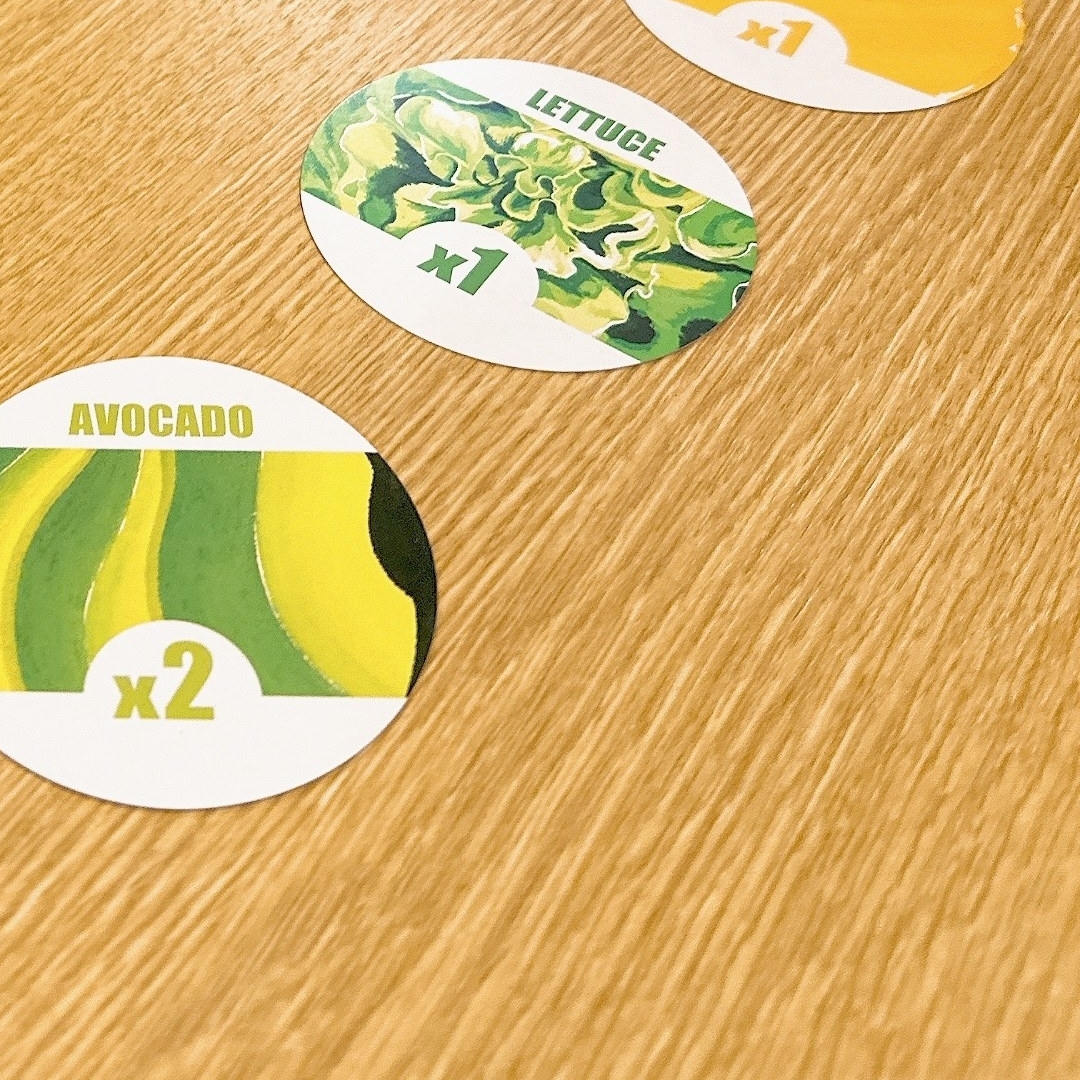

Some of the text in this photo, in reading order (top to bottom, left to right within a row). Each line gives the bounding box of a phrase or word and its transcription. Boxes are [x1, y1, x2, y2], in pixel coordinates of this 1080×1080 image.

[736, 19, 813, 57] x1
[525, 88, 666, 161] LETTUCE
[416, 244, 508, 295] x1
[68, 403, 254, 438] AVOCADO
[113, 640, 215, 720] x2
